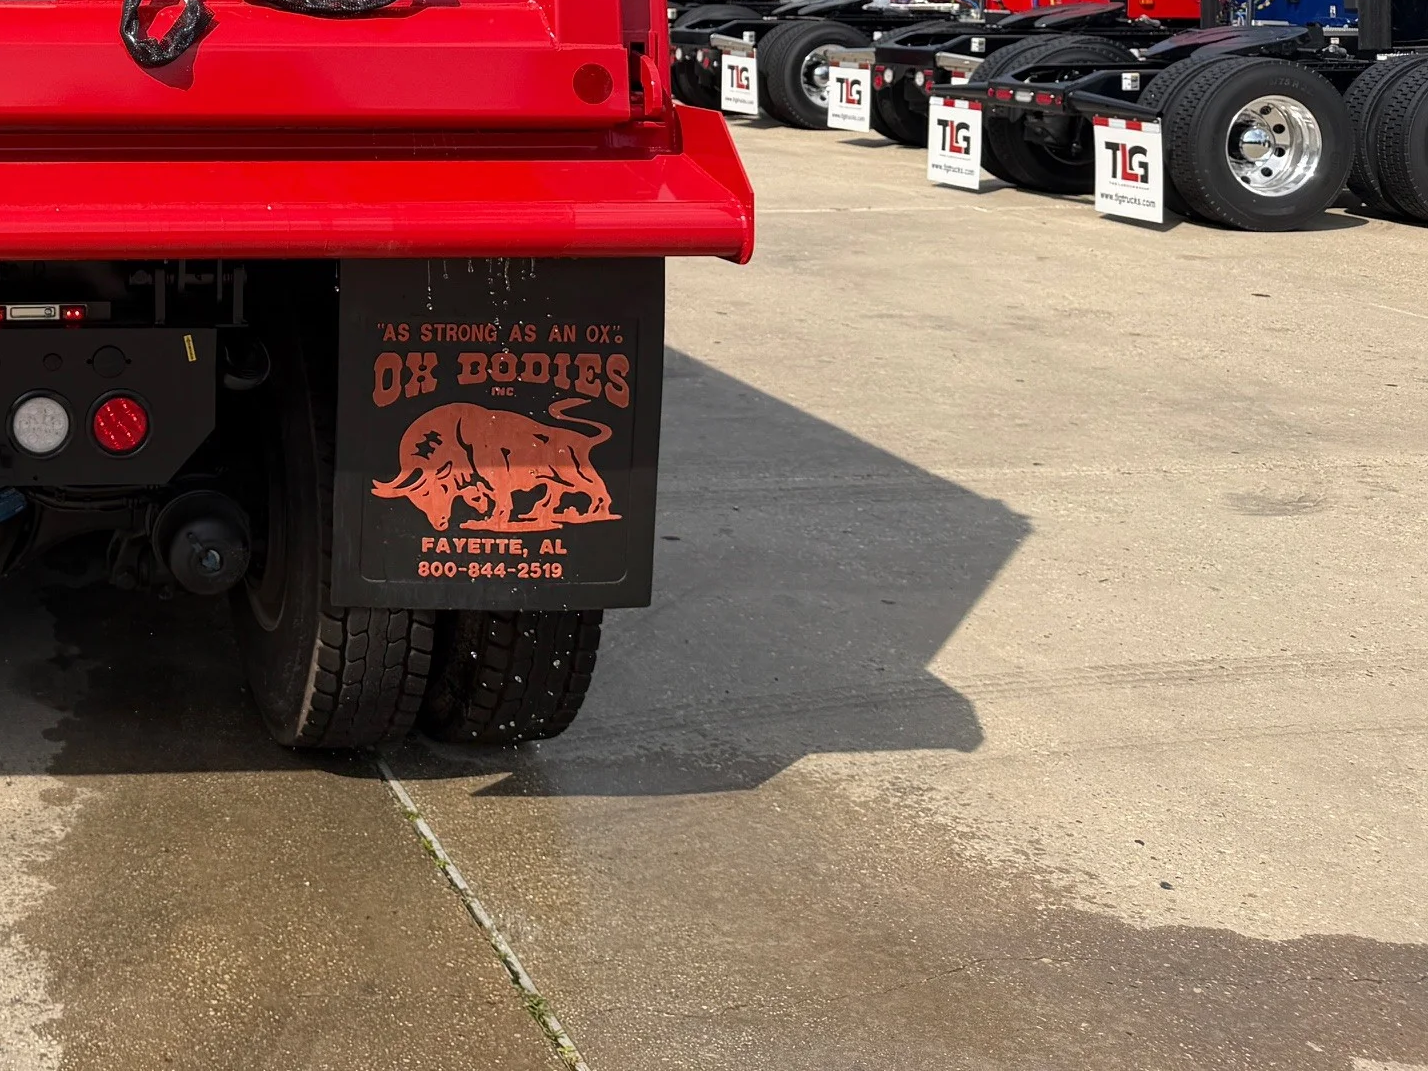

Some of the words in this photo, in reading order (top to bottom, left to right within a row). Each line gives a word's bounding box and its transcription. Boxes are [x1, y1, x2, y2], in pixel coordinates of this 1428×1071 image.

[727, 64, 750, 90] TLG
[836, 77, 862, 105] TLG
[937, 118, 971, 156] TLG
[1104, 140, 1149, 184] TLG
[420, 323, 498, 343] STRONG
[509, 324, 537, 342] AS
[548, 324, 576, 343] AN
[372, 352, 438, 408] OX
[457, 352, 630, 409] BODIES
[422, 537, 529, 558] FAYETTE,
[539, 538, 568, 555] AL
[418, 561, 563, 579] 800-844-2519
